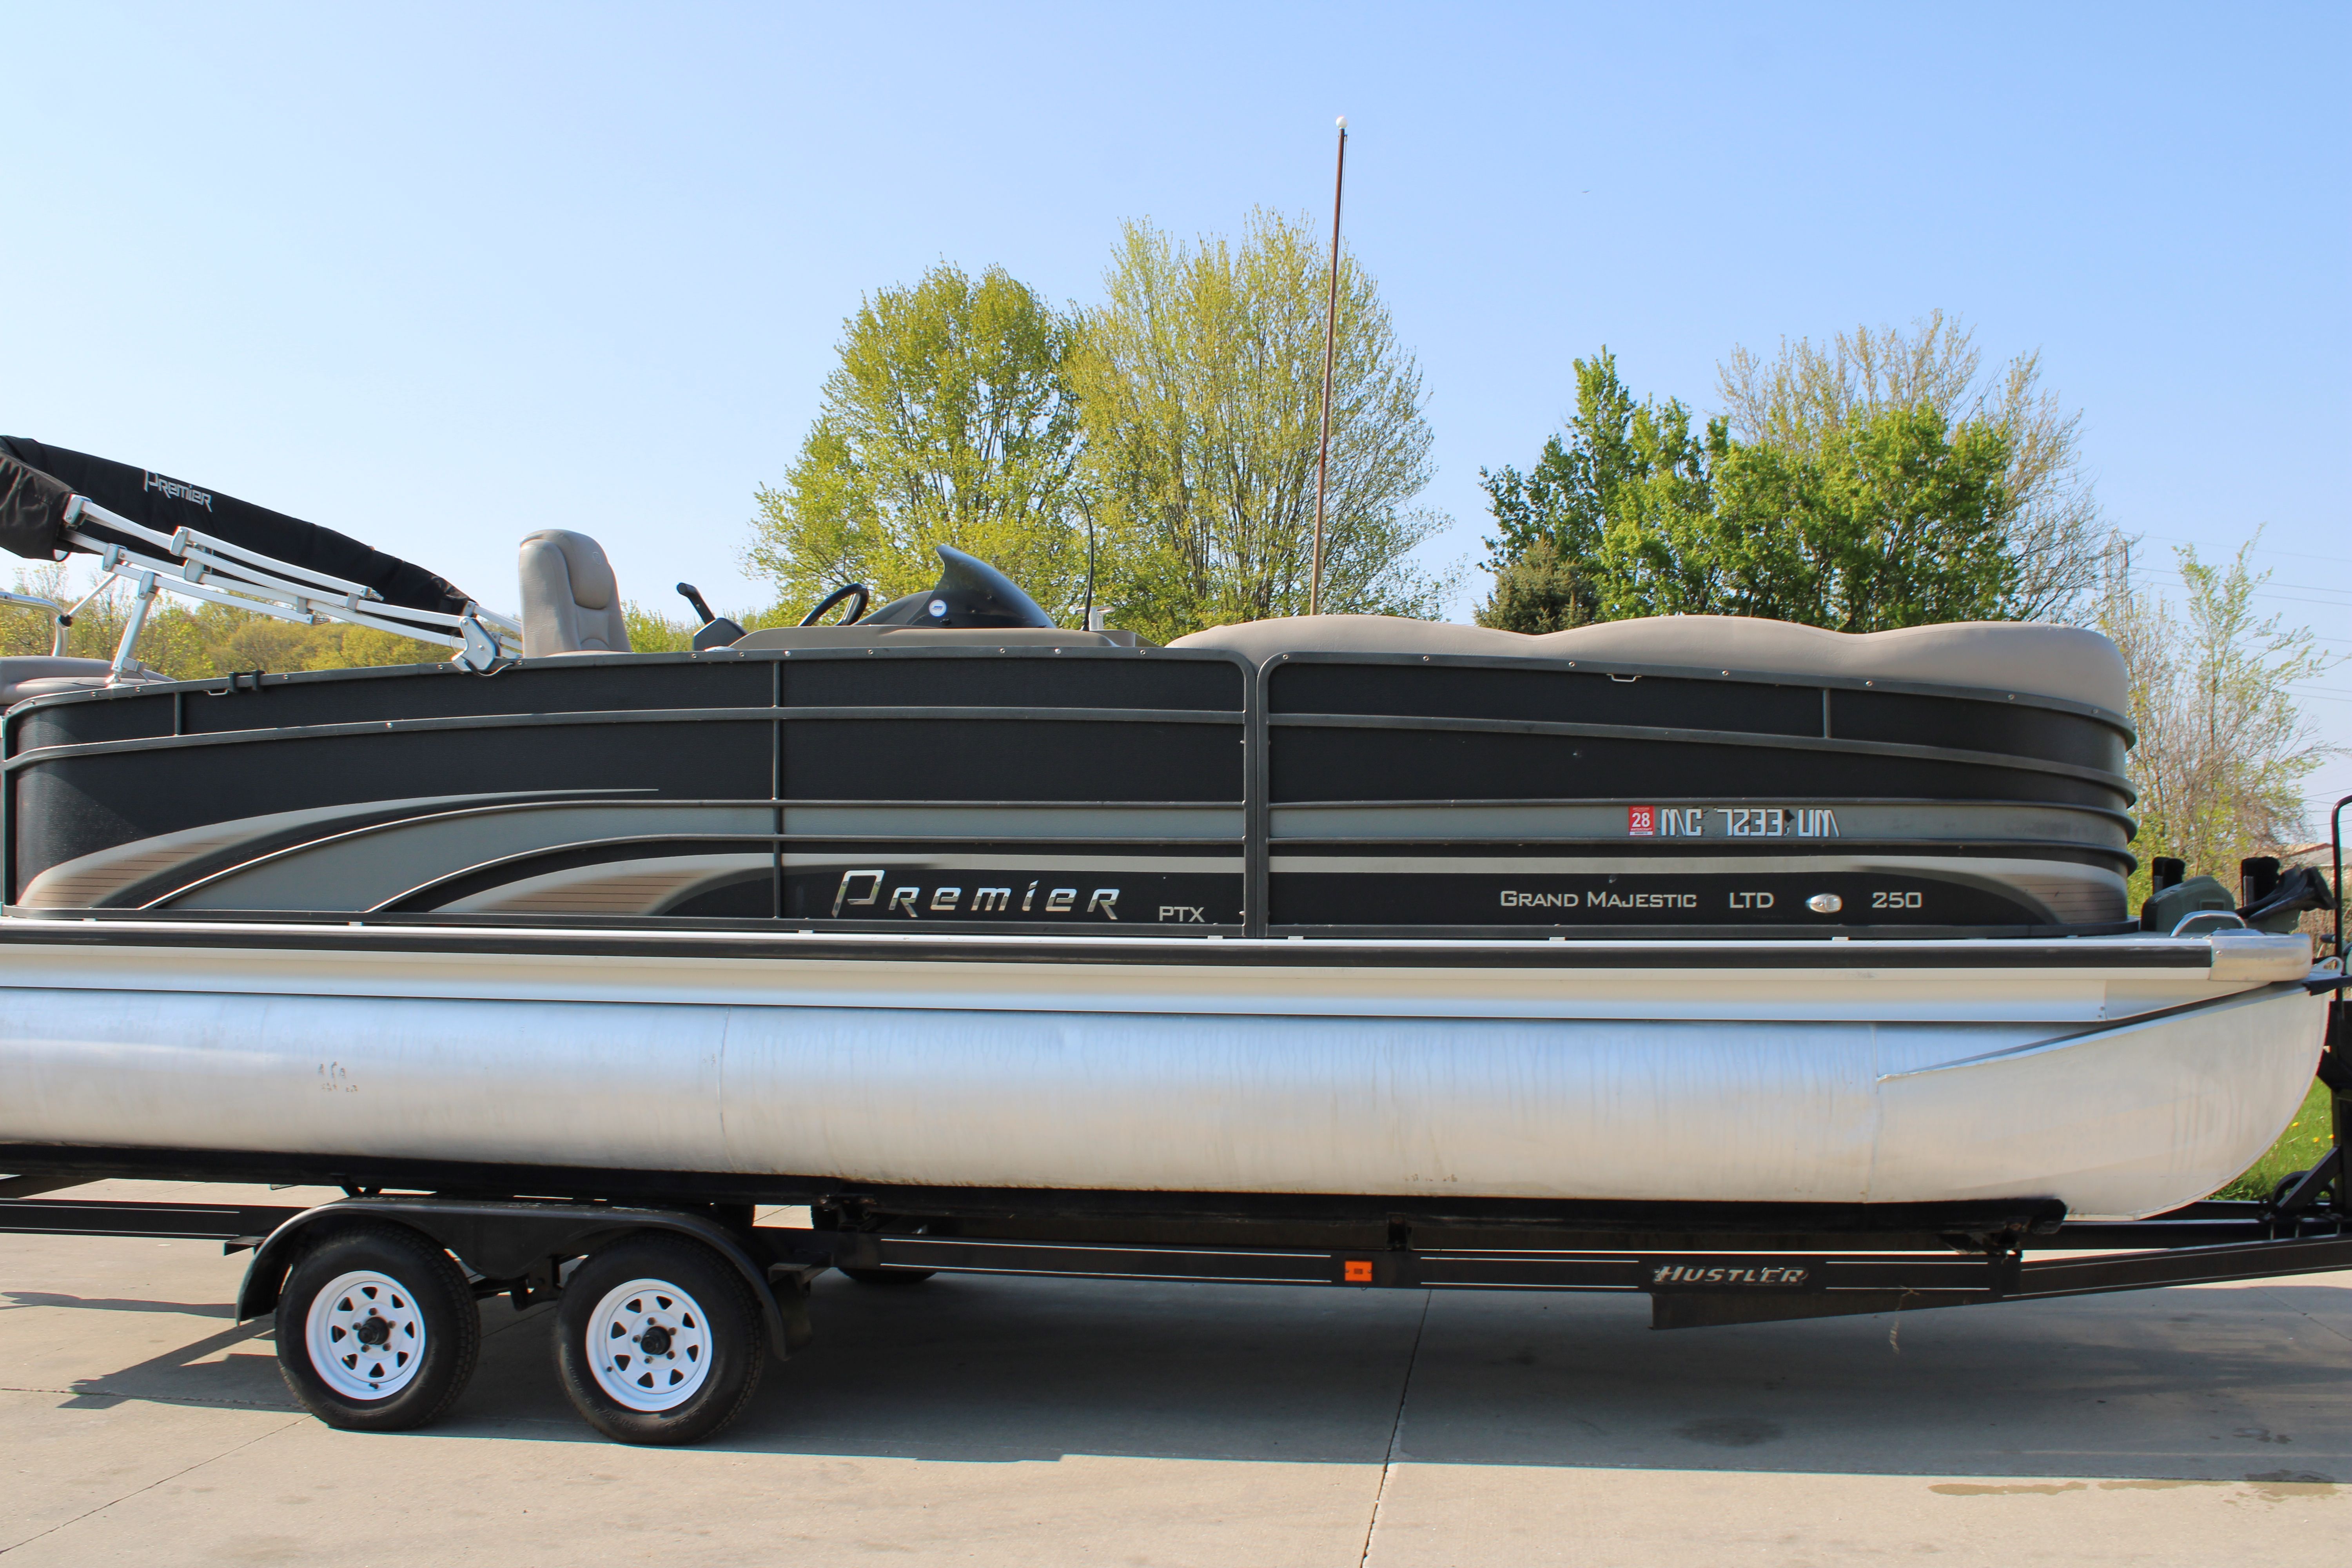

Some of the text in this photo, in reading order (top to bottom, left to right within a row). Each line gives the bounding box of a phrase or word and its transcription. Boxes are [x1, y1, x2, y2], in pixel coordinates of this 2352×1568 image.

[1632, 812, 1650, 828] 28
[1661, 809, 1839, 837] MC 7233 UM
[1501, 891, 1922, 908] GRAND MAJESTIC LTD 250
[1159, 906, 1205, 923] PTX
[1654, 1266, 1804, 1282] HUSTLER
